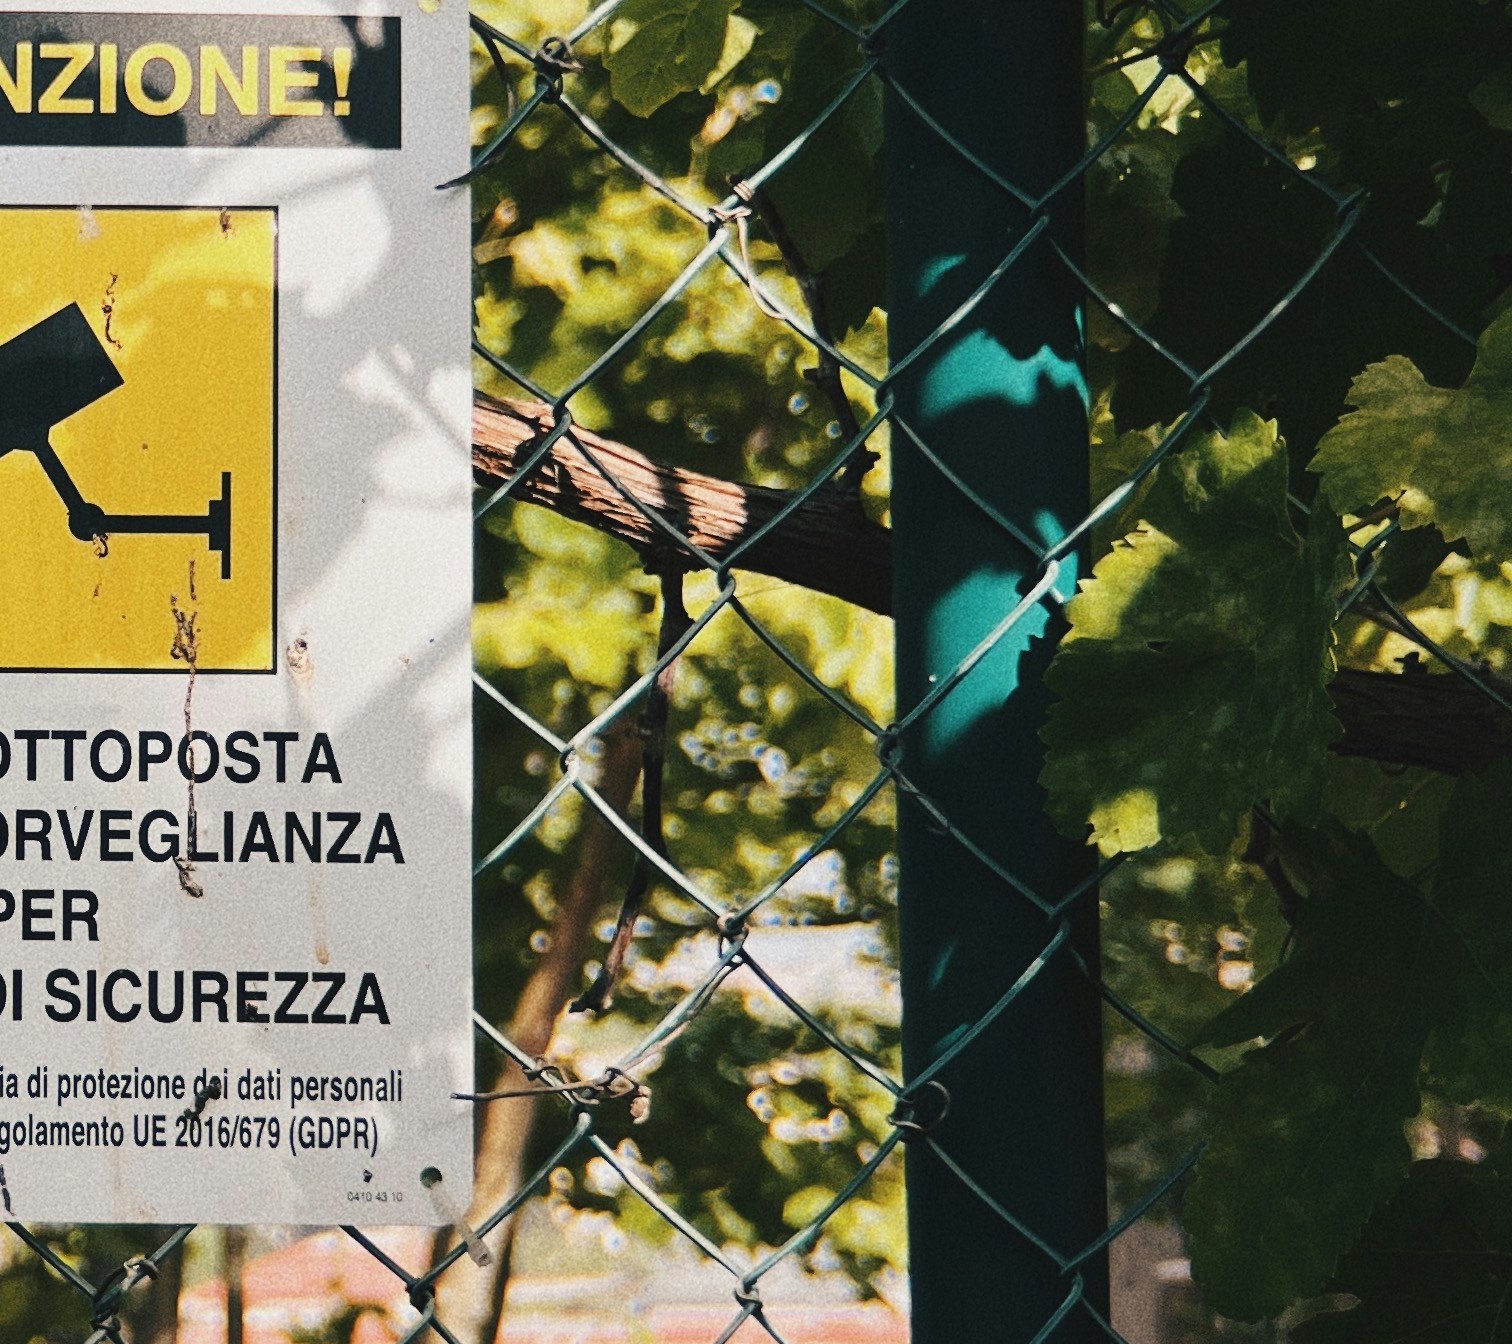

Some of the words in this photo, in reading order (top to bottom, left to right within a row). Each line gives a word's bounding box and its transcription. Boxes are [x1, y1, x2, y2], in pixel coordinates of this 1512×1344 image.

[45, 970, 391, 1026] SICUREZZA
[27, 1066, 48, 1098] di
[58, 1067, 185, 1106] protezione
[238, 1069, 281, 1101] dati
[291, 1069, 402, 1108] personali
[134, 1114, 166, 1146] UE
[175, 1115, 280, 1148] 2016/679
[290, 1116, 378, 1156] (GDPR)
